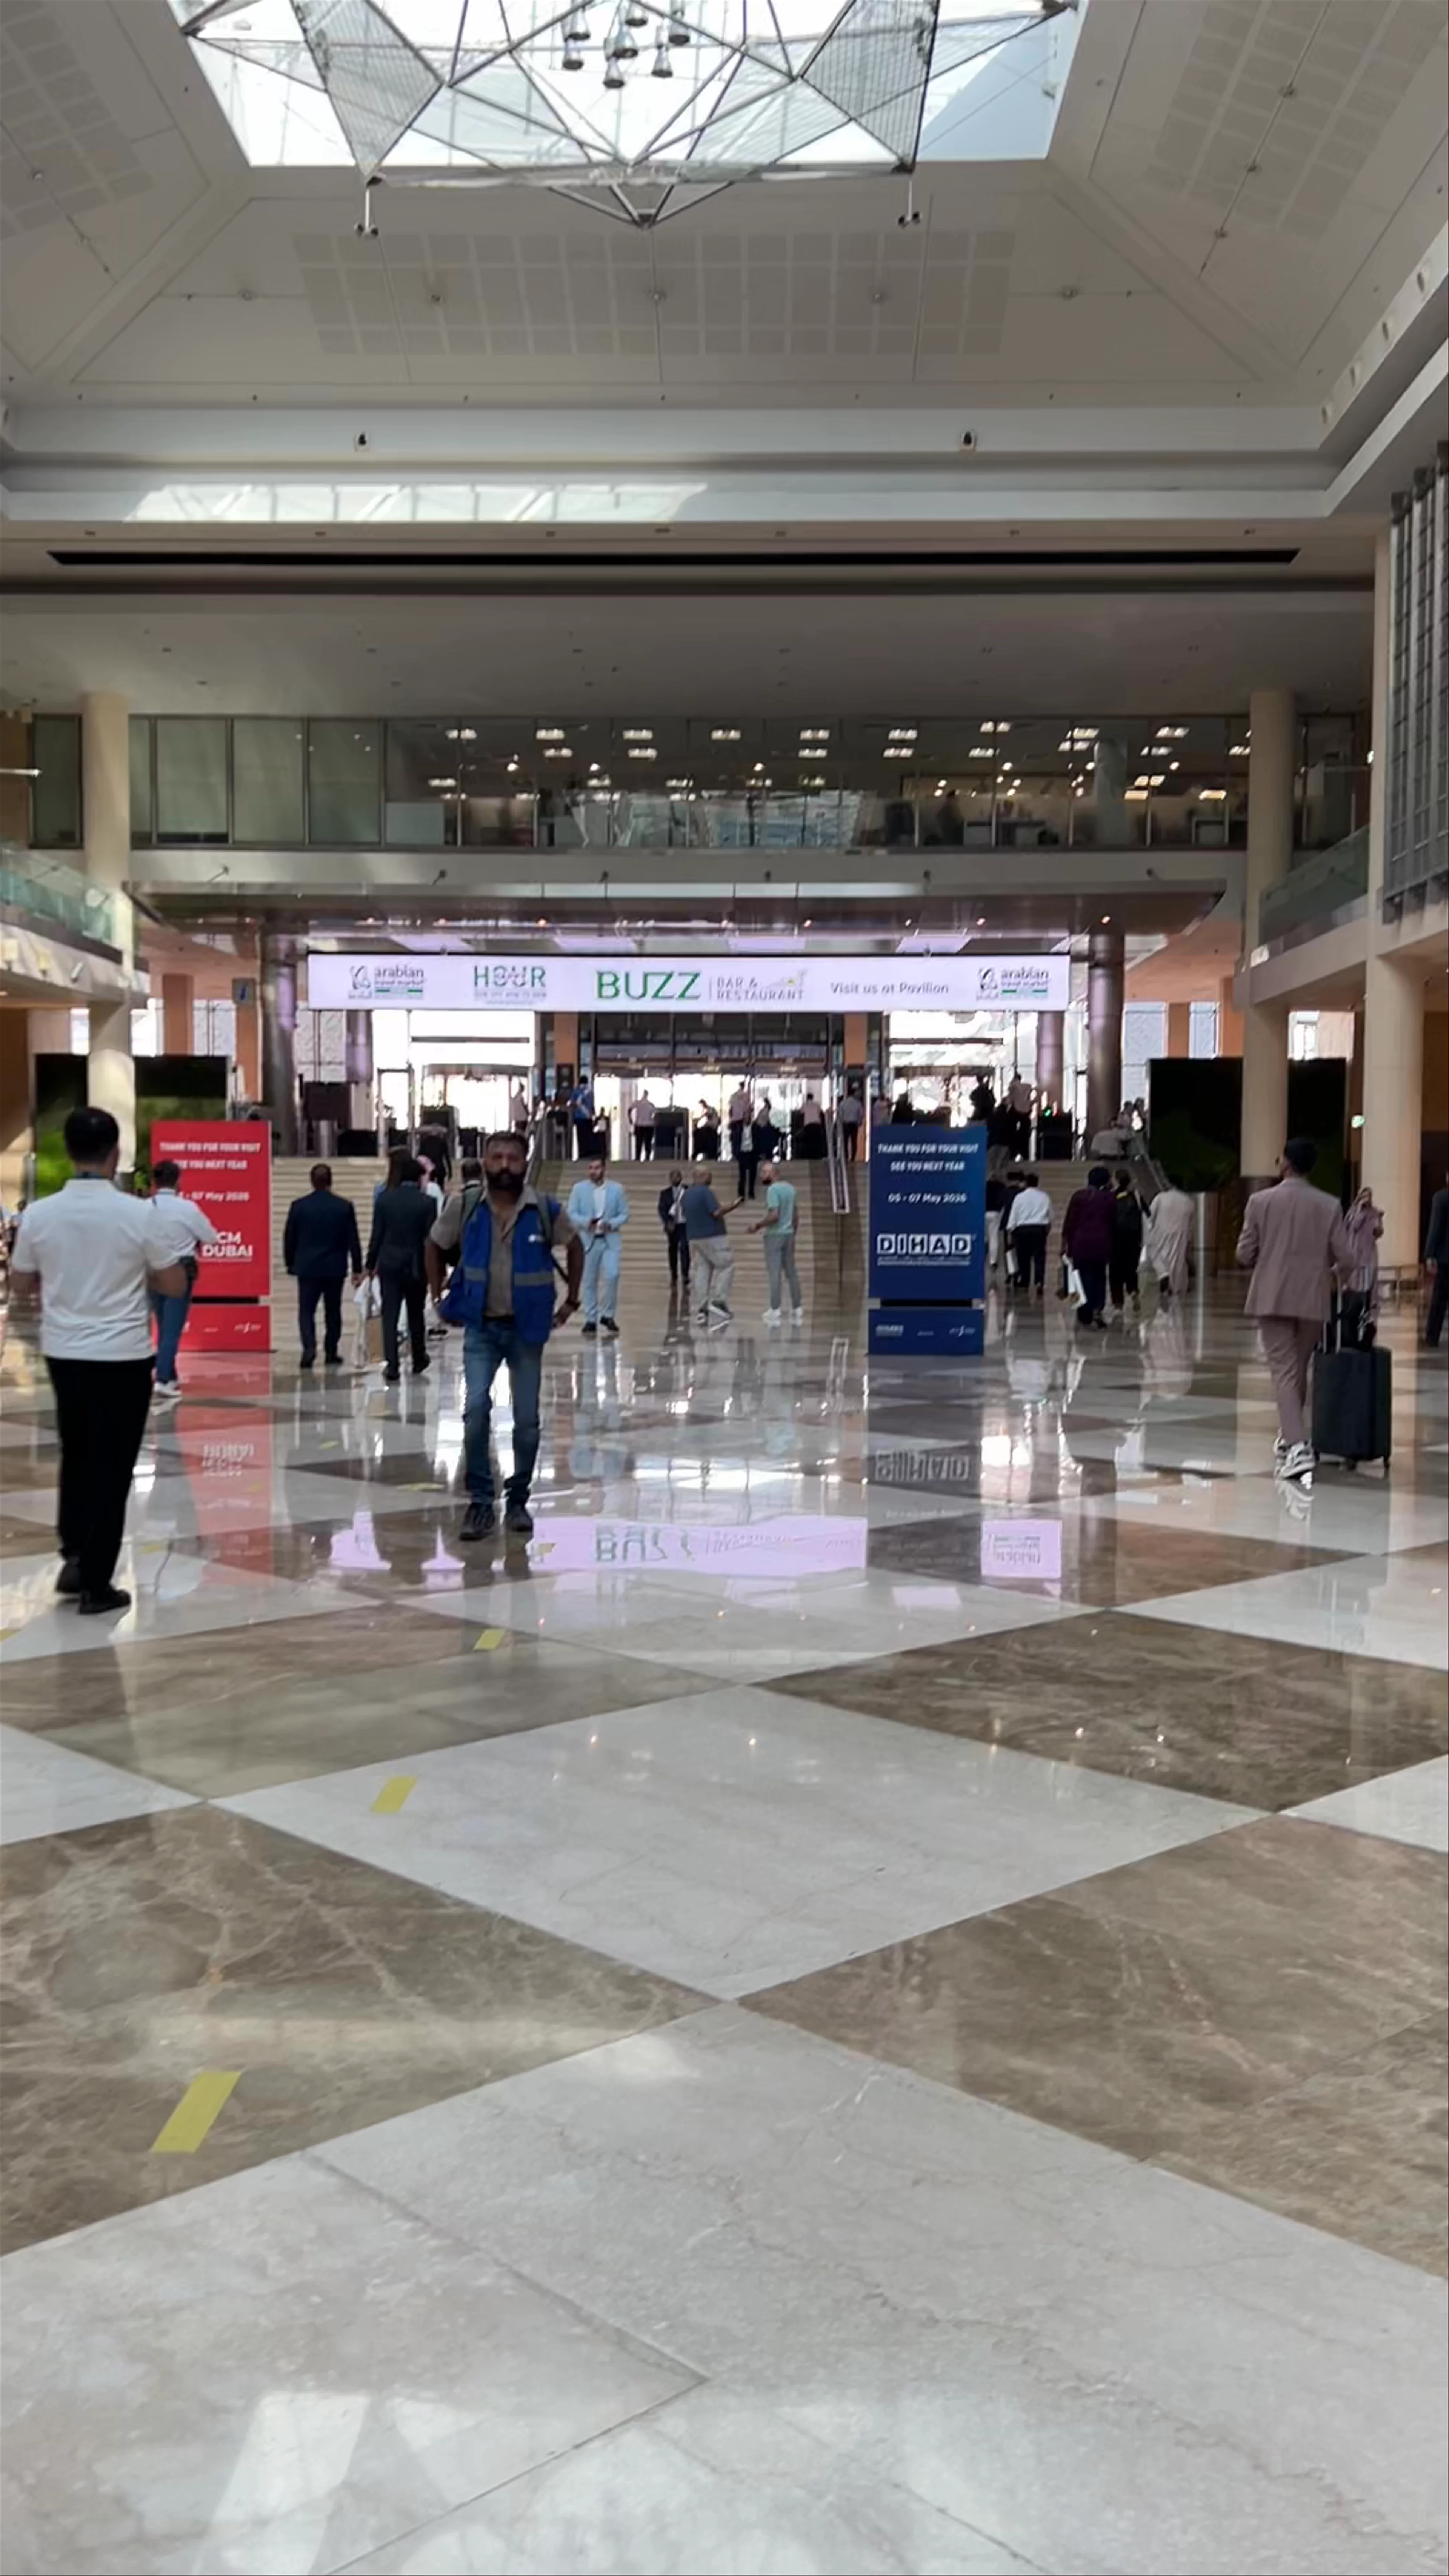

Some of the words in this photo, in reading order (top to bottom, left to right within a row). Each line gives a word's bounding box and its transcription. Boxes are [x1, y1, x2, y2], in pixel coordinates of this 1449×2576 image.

[375, 965, 424, 977] arabian
[1001, 966, 1048, 978] arabian
[596, 971, 702, 1000] BUZZ
[717, 976, 743, 988] BAR
[749, 977, 757, 988] &
[830, 982, 859, 994] Visit
[863, 984, 878, 994] us
[881, 983, 894, 994] at
[899, 981, 949, 994] Pavilion
[716, 989, 803, 1000] RESTAURANT
[159, 1142, 185, 1152] THANK
[186, 1142, 203, 1152] YOU
[203, 1142, 218, 1152] FOR
[220, 1142, 240, 1152] YOUR
[242, 1142, 261, 1153] VISIT
[878, 1143, 904, 1154] THANK
[905, 1143, 920, 1154] YOU
[921, 1143, 937, 1154] FOR
[938, 1143, 958, 1154] YOUR
[959, 1143, 979, 1154] VISIT
[189, 1160, 204, 1169] YOU
[205, 1160, 225, 1169] NEXT
[226, 1160, 248, 1170] YEAR
[890, 1161, 906, 1172] SEE
[907, 1161, 922, 1172] YOU
[923, 1161, 943, 1172] NEXT
[945, 1161, 965, 1172] YEAR
[205, 1191, 224, 1202] May
[908, 1193, 921, 1203] 07
[922, 1193, 942, 1204] May
[878, 1235, 971, 1253] DIHAD
[202, 1244, 253, 1257] DUBAI
